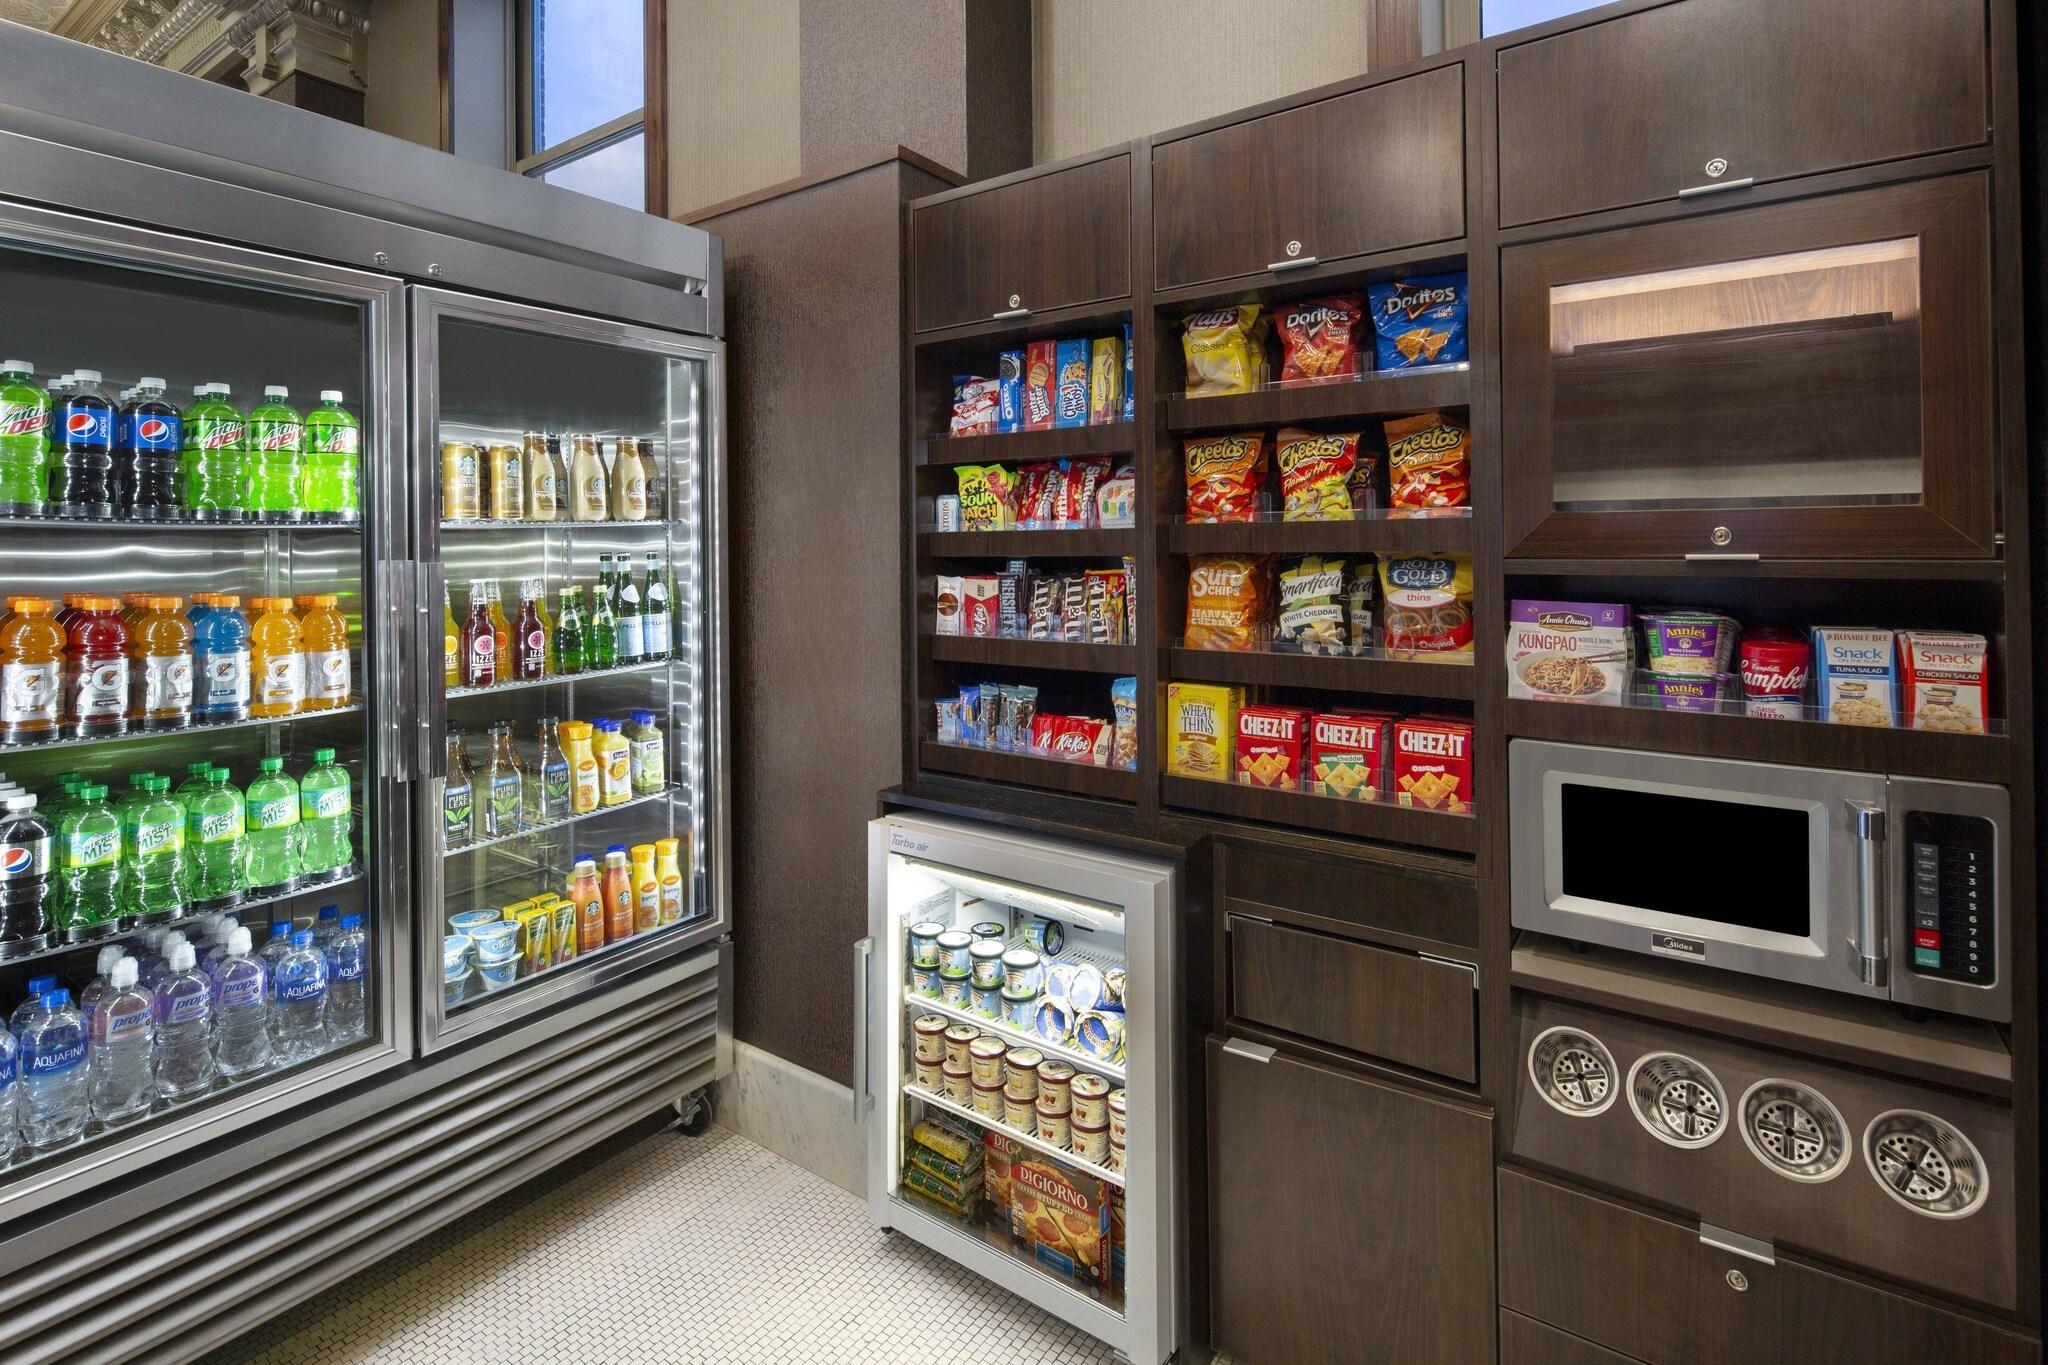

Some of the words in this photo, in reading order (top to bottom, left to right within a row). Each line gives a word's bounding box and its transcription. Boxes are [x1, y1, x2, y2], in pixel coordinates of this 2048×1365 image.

[1387, 287, 1455, 314] Doritos
[1287, 308, 1349, 328] Doritos
[1191, 343, 1225, 354] Classic
[1003, 384, 1013, 419] OREO
[1029, 391, 1042, 423] Nutter
[1035, 385, 1050, 416] Butter
[1063, 391, 1077, 419] Chips
[99, 417, 108, 438] pepsi
[1388, 427, 1461, 465] Cheetos
[1187, 439, 1245, 472] Cheetos
[1280, 438, 1343, 474] Cheetos
[960, 492, 996, 507] SOUR
[1401, 560, 1446, 570] ROLD
[1393, 569, 1448, 584] GOLD
[1208, 585, 1241, 596] CHIPS
[1407, 593, 1432, 602] thins
[1002, 580, 1016, 634] HERSHEY'S
[1283, 612, 1304, 624] WHITE
[1303, 609, 1338, 618] CHEDDAR
[1541, 614, 1564, 625] Annie
[1564, 614, 1591, 626] Chun's
[1666, 627, 1706, 638] Annie's
[1419, 637, 1456, 649] Original
[1518, 634, 1577, 651] KUNGPAO
[476, 655, 494, 663] IZZE
[530, 648, 545, 657] IZZE
[1833, 646, 1883, 659] Snack
[1920, 651, 1974, 664] Snack
[1664, 684, 1705, 696] Annie's
[1181, 704, 1214, 719] WHEAT
[1181, 716, 1214, 734] THINS
[1056, 734, 1088, 752] KitKat
[550, 769, 567, 779] PURE
[448, 793, 468, 803] PURE
[202, 816, 235, 840] MIST
[892, 833, 915, 849] Turbo
[916, 842, 929, 851] air
[1968, 852, 1975, 860] 1
[1968, 865, 1977, 873] 2
[1968, 878, 1977, 886] 3
[1968, 890, 1977, 898] 4
[1969, 915, 1978, 923] 6
[1666, 939, 1693, 951] Midea
[1969, 940, 1978, 948] 8
[1969, 953, 1978, 961] 9
[286, 980, 326, 998] AQUAFINA
[33, 1043, 86, 1068] AQUAFINA
[1020, 1167, 1088, 1210] DIGIORNO
[1037, 1192, 1074, 1216] STUFFED
